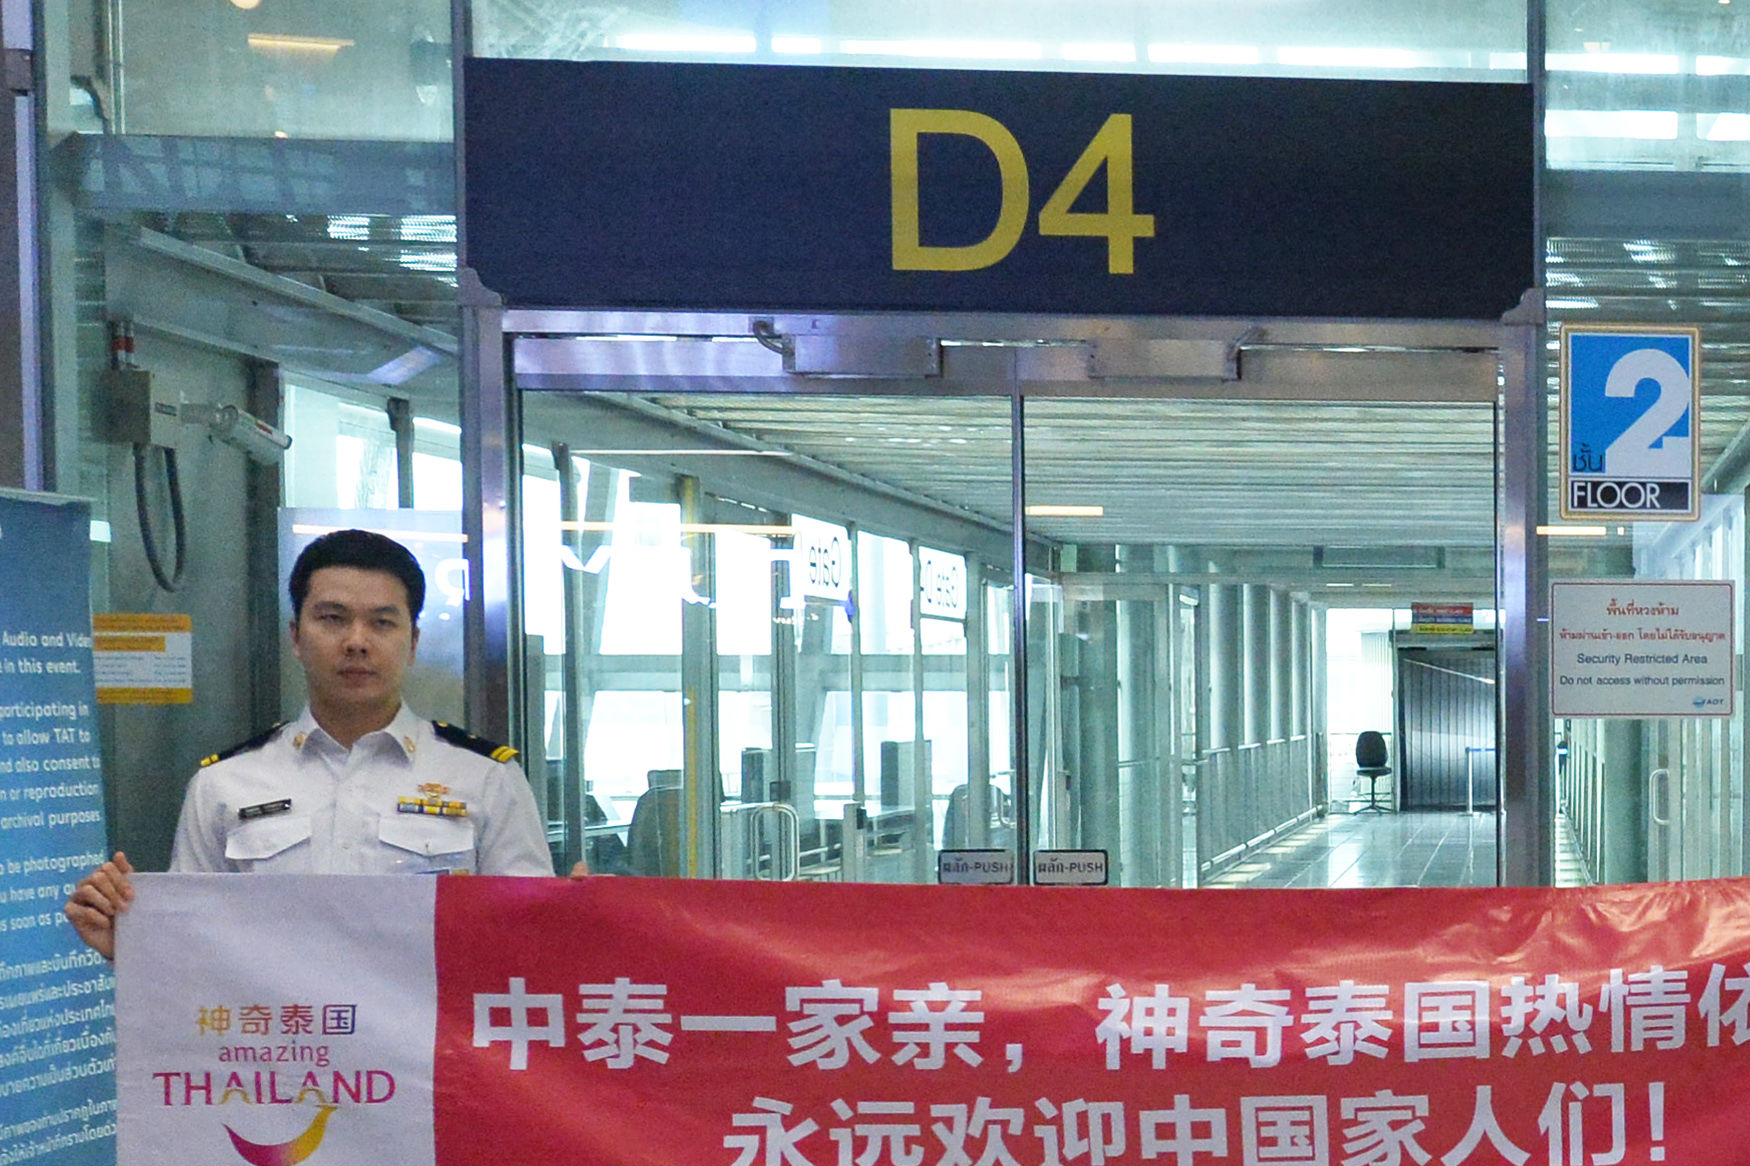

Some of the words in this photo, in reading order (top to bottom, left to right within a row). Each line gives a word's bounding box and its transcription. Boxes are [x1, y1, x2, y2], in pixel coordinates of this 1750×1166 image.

[890, 108, 1155, 274] D4
[1605, 349, 1692, 477] 2
[1573, 442, 1606, 472] ชั้น
[1573, 482, 1661, 508] FLOOR
[2, 630, 38, 647] Audio
[41, 631, 64, 647] and
[66, 631, 93, 648] Vide
[4, 658, 15, 673] in
[18, 658, 43, 673] this
[45, 661, 81, 673] event.
[1577, 653, 1620, 666] Security
[1624, 653, 1679, 664] Restricted
[1682, 654, 1708, 664] Area
[1560, 676, 1574, 685] Do
[1577, 676, 1592, 685] not
[1634, 675, 1669, 685] without
[1672, 676, 1725, 687] permission
[79, 701, 90, 716] in
[2, 731, 14, 745] to
[16, 730, 50, 745] allow
[53, 728, 75, 743] TAT
[79, 729, 91, 743] to
[15, 757, 40, 772] also
[43, 756, 91, 771] consent
[23, 783, 99, 802] reproduction
[1, 811, 45, 829] archival
[7, 859, 21, 873] be
[38, 886, 60, 900] any
[10, 915, 36, 930] soon
[195, 1003, 358, 1036] 神奇泰国
[218, 1040, 330, 1068] amazing
[152, 1070, 396, 1107] THAILAND
